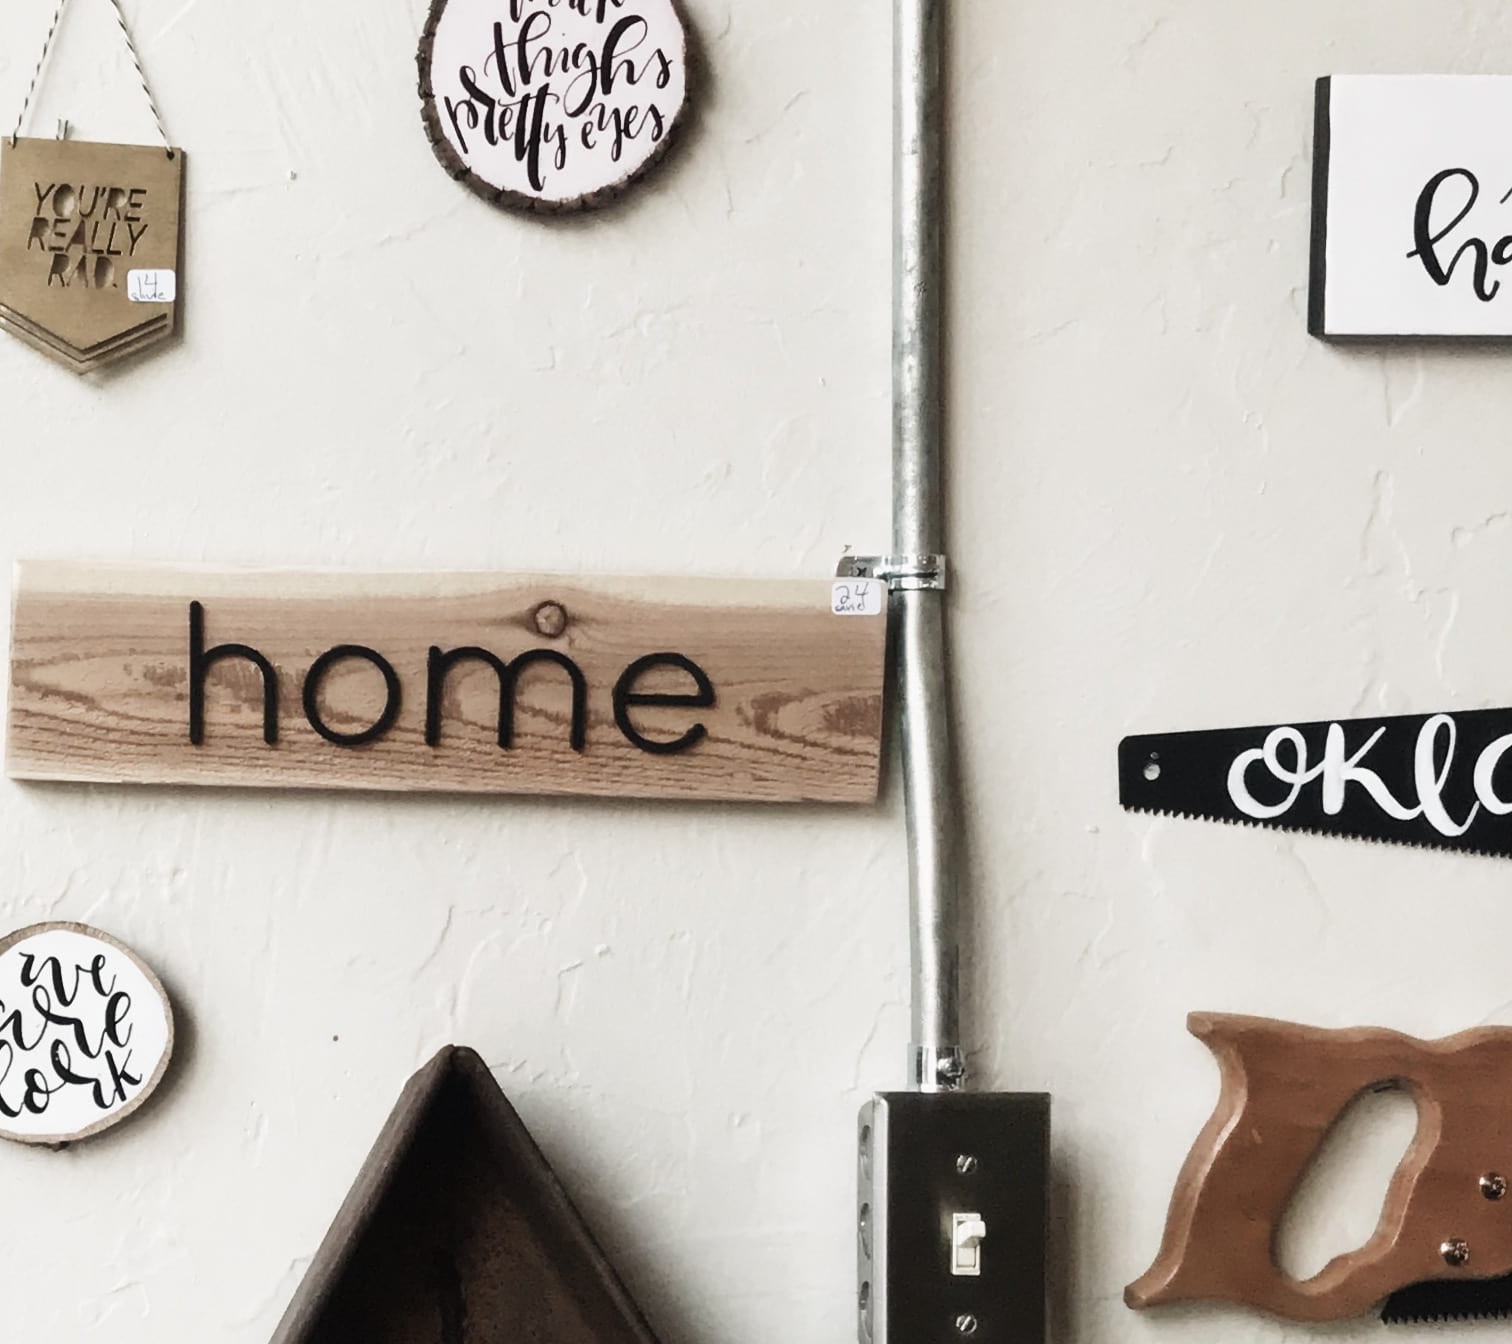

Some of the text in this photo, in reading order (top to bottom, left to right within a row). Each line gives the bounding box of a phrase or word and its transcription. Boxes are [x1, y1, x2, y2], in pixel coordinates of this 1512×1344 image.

[484, 10, 672, 118] thighs
[444, 65, 665, 192] pretty eyes
[27, 216, 148, 257] REALLY
[34, 182, 148, 222] YOU'RE
[189, 600, 715, 754] home
[19, 952, 116, 1007] we
